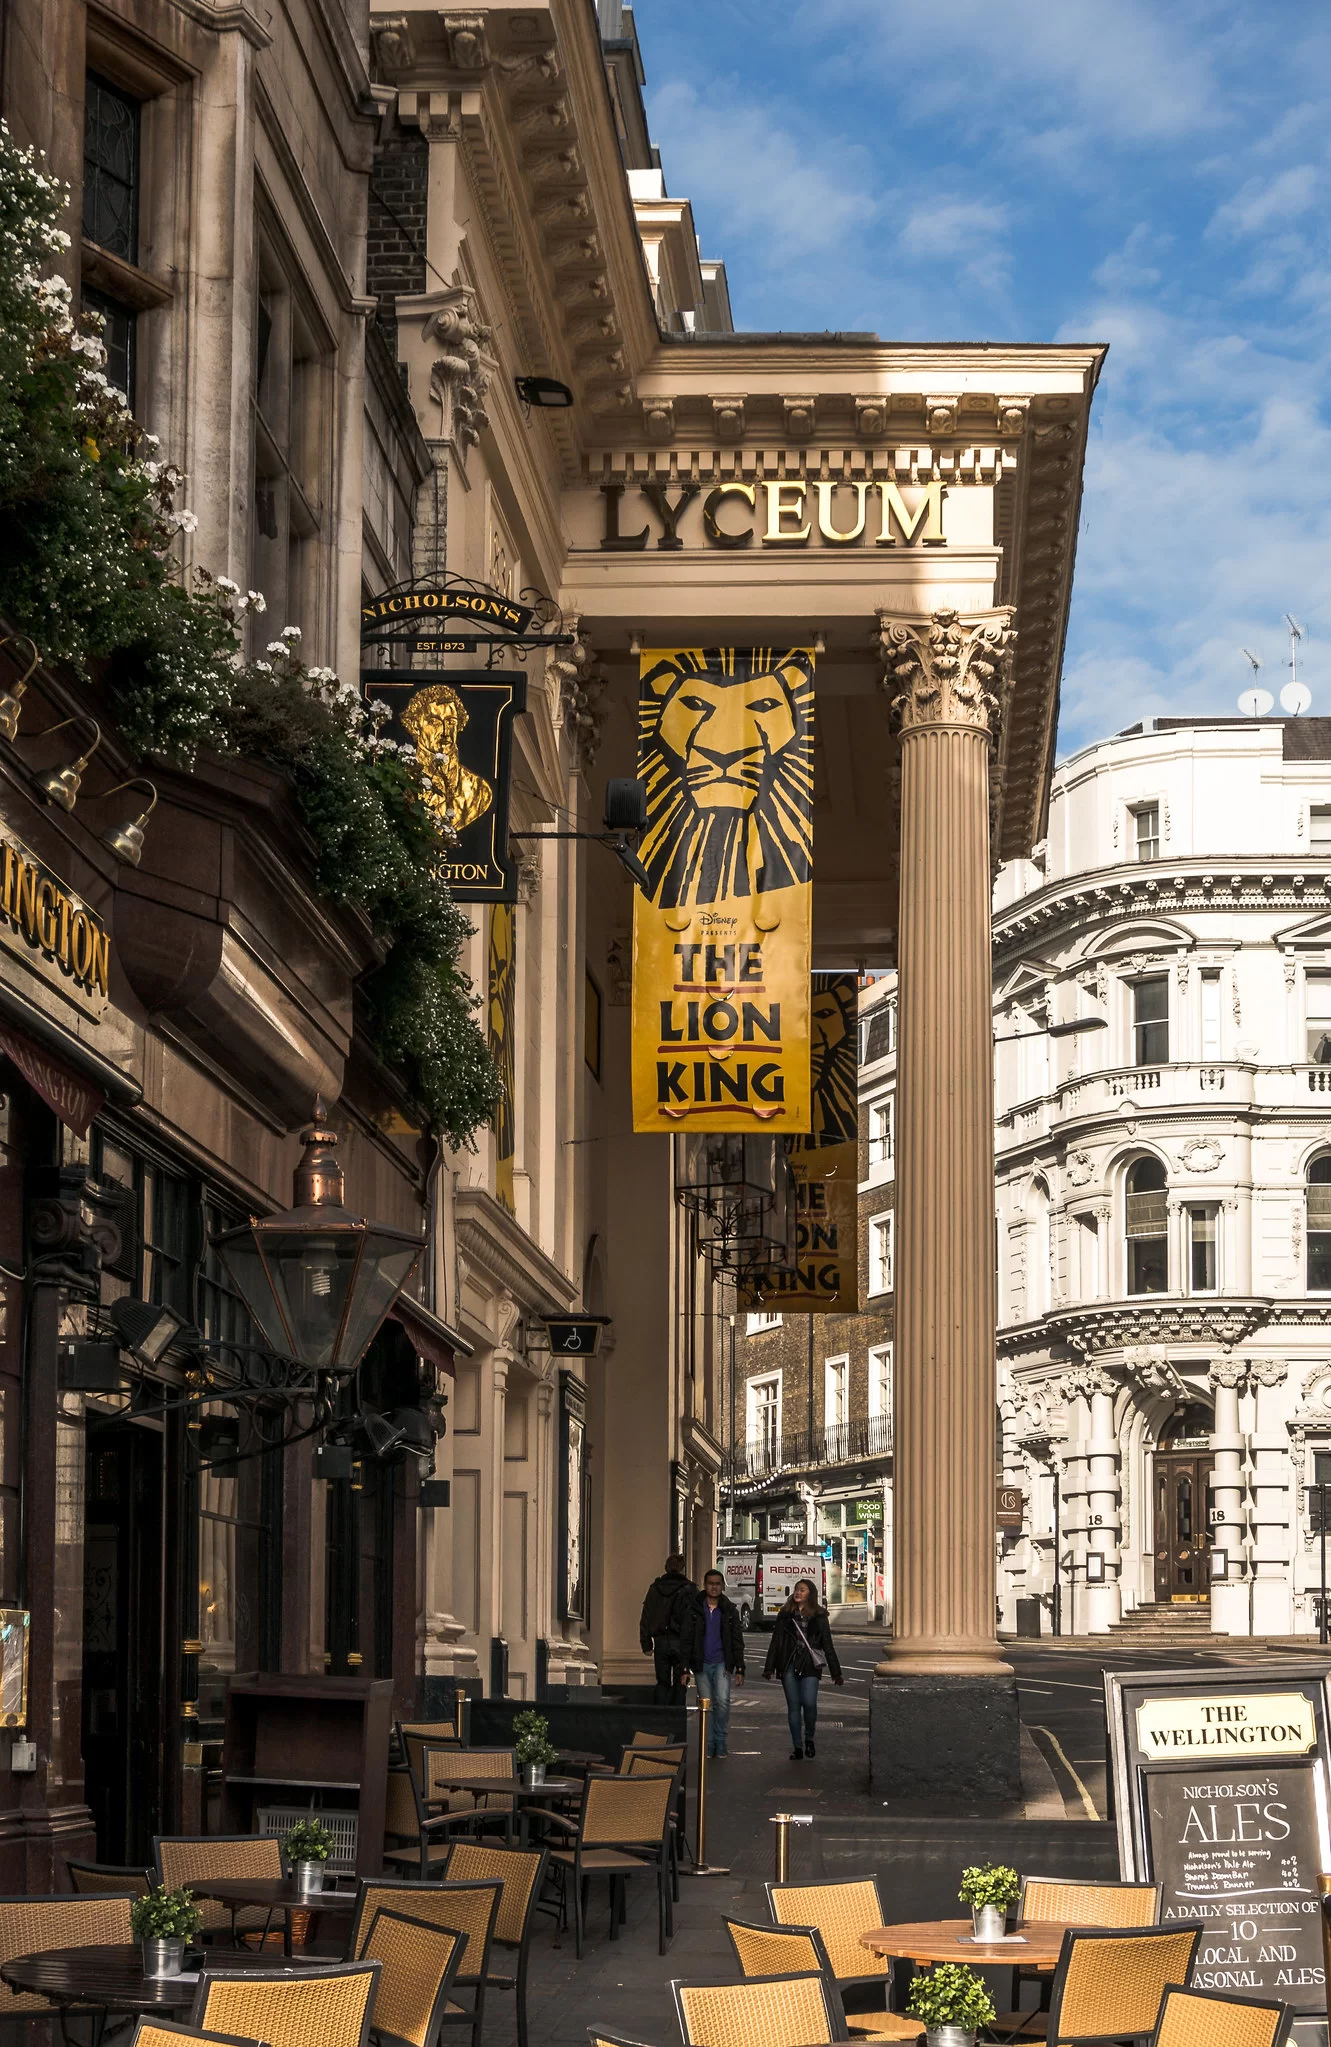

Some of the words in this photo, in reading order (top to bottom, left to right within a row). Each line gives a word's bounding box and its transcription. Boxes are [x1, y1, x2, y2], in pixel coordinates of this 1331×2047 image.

[601, 480, 948, 550] LYCEUM
[361, 594, 521, 624] NICHOLSON'S
[697, 911, 738, 928] Disney
[673, 943, 764, 982] THE
[660, 1002, 781, 1041] LION
[656, 1062, 785, 1102] KING
[1088, 1515, 1103, 1526] 18
[1211, 1511, 1225, 1522] 18
[727, 1566, 753, 1576] REDDAN
[769, 1567, 816, 1575] REDDAN
[1201, 1706, 1248, 1723] THE
[1150, 1724, 1302, 1747] WELLINGTON
[1183, 1778, 1279, 1799] NICHOLSON'S
[1178, 1803, 1291, 1844] ALES
[1188, 1852, 1209, 1861] Always
[1211, 1850, 1230, 1860] proud
[1239, 1849, 1246, 1857] be
[1248, 1849, 1272, 1860] serving
[1183, 1862, 1222, 1871] Nicholson's
[1223, 1859, 1240, 1868] Pale
[1242, 1860, 1256, 1868] Ale
[1184, 1873, 1209, 1882] Sharp's
[1184, 1882, 1219, 1891] Truman's
[1222, 1881, 1255, 1889] Runner
[1165, 1908, 1177, 1919] A
[1178, 1904, 1224, 1918] DAILY
[1225, 1902, 1300, 1917] SELECTION
[1301, 1901, 1319, 1913] OF
[1230, 1920, 1258, 1941] 10
[1195, 1946, 1249, 1965] LOCAL
[1256, 1945, 1297, 1963] AND
[1273, 1967, 1326, 1985] ALES
